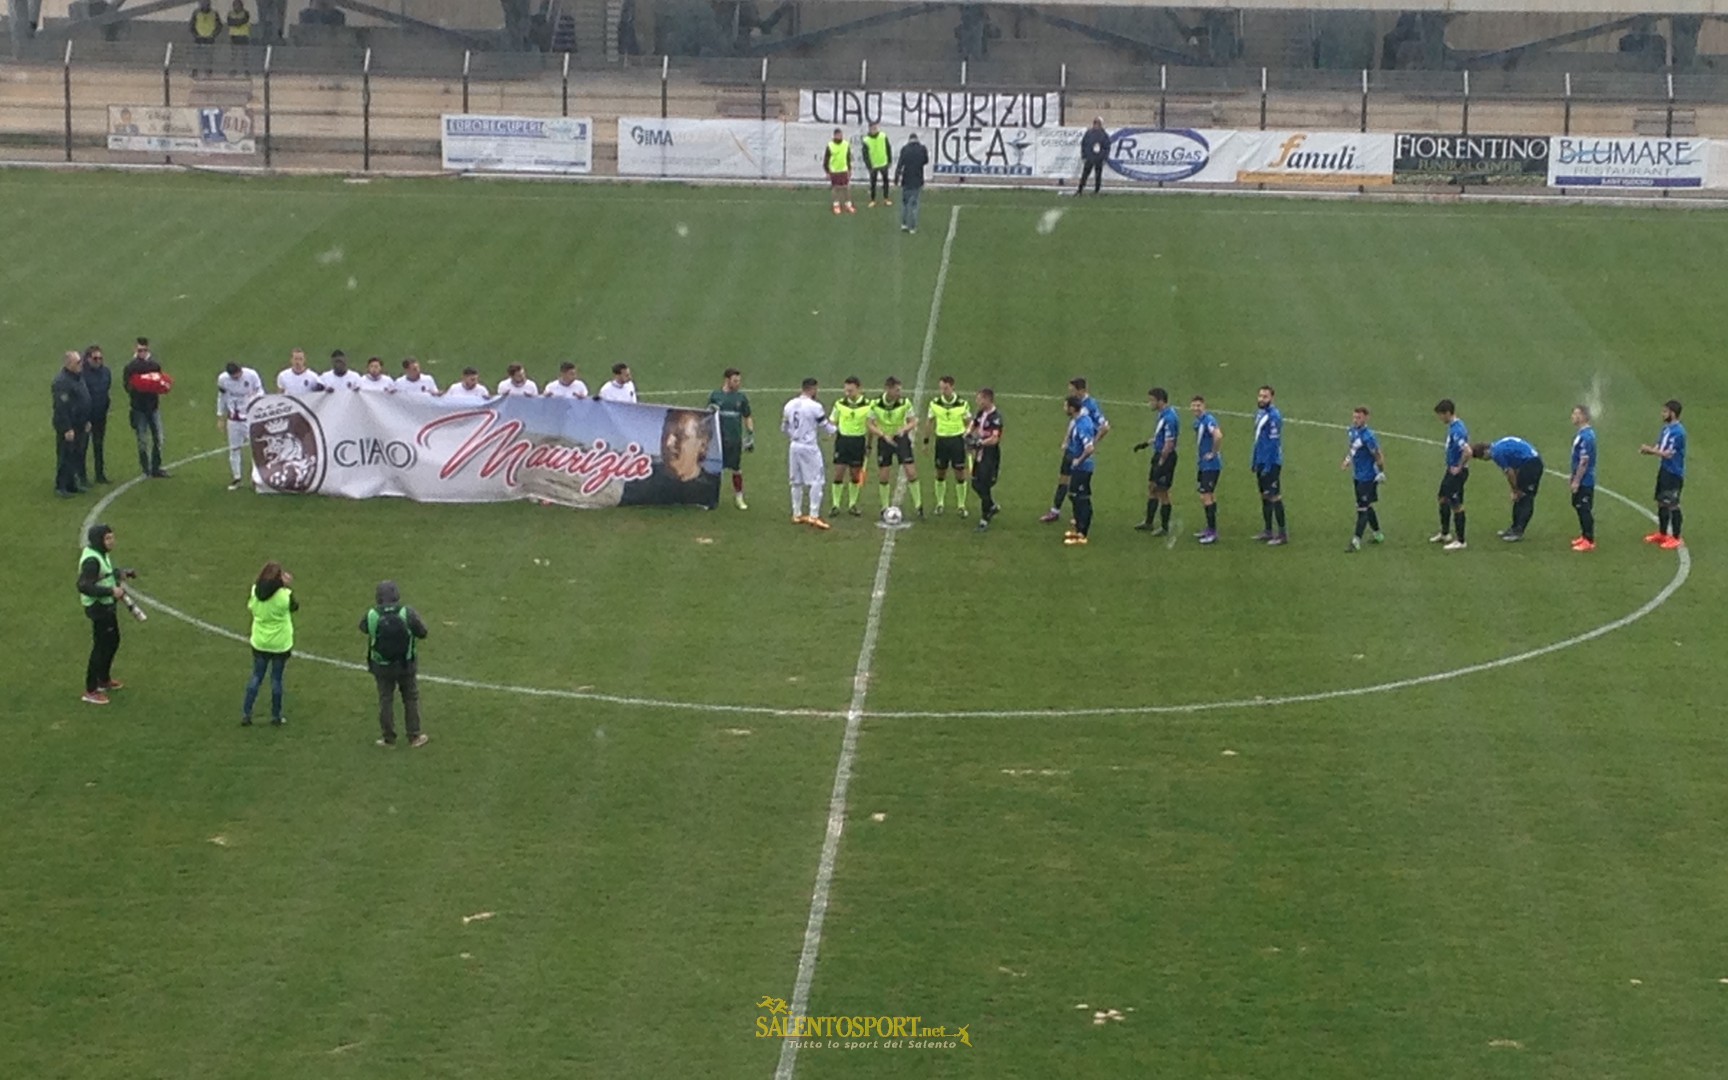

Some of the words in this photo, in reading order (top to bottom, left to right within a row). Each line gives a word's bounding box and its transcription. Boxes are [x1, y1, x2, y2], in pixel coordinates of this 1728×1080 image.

[813, 90, 883, 125] CIAO
[901, 92, 1047, 128] MAURIZIO
[1396, 135, 1548, 160] FIORENTINO
[1557, 139, 1693, 166] BLUMARE
[1573, 166, 1672, 176] RESTAURANT
[333, 439, 418, 469] CIAO
[416, 408, 653, 495] Maurizio
